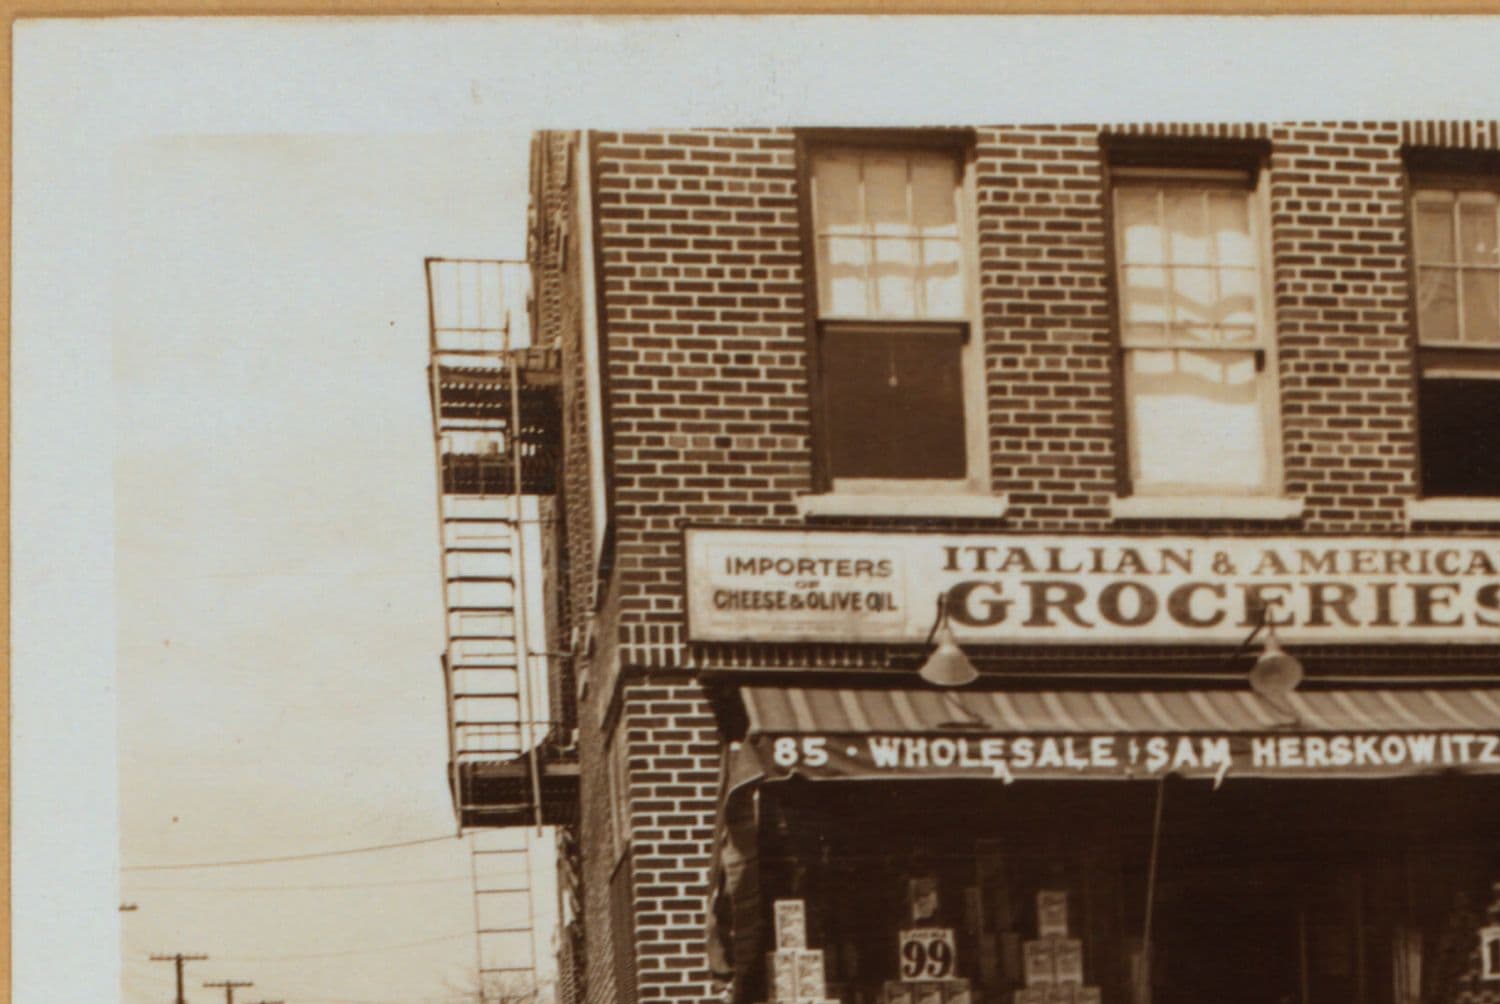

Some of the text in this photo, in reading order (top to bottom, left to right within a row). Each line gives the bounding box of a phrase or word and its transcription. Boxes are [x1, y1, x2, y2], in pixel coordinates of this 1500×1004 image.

[725, 556, 893, 578] IMPORTERS
[942, 546, 1195, 576] ITALIAN
[1211, 550, 1237, 575] &
[794, 580, 821, 590] OF
[713, 588, 897, 613] CHEESE & OLIVE OIL
[773, 736, 830, 768] 85
[867, 736, 1118, 769] WHOLESALE
[1145, 735, 1231, 770] SAM
[903, 939, 953, 978] 99
